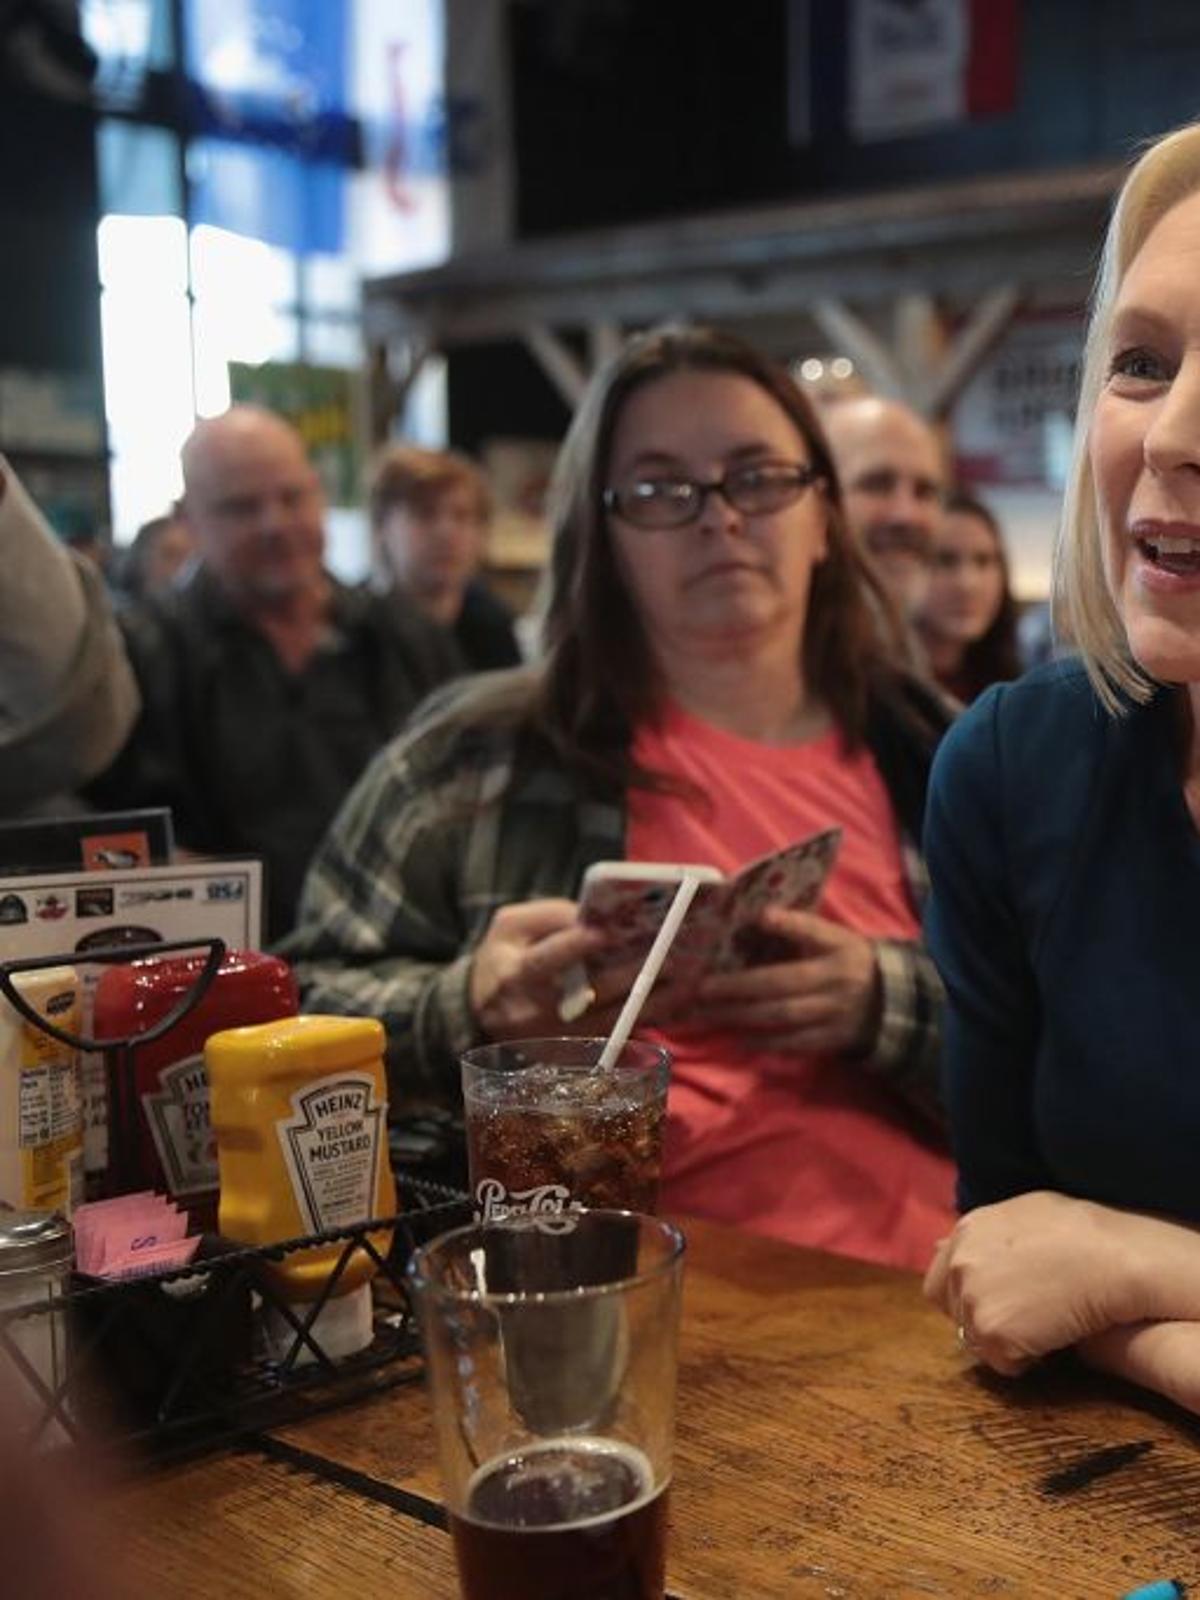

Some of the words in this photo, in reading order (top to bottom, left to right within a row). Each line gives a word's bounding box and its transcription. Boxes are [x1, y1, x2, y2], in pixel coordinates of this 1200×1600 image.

[316, 1093, 362, 1118] HEINZ
[316, 1119, 364, 1143] YELLOW
[309, 1134, 372, 1162] MUSTARD
